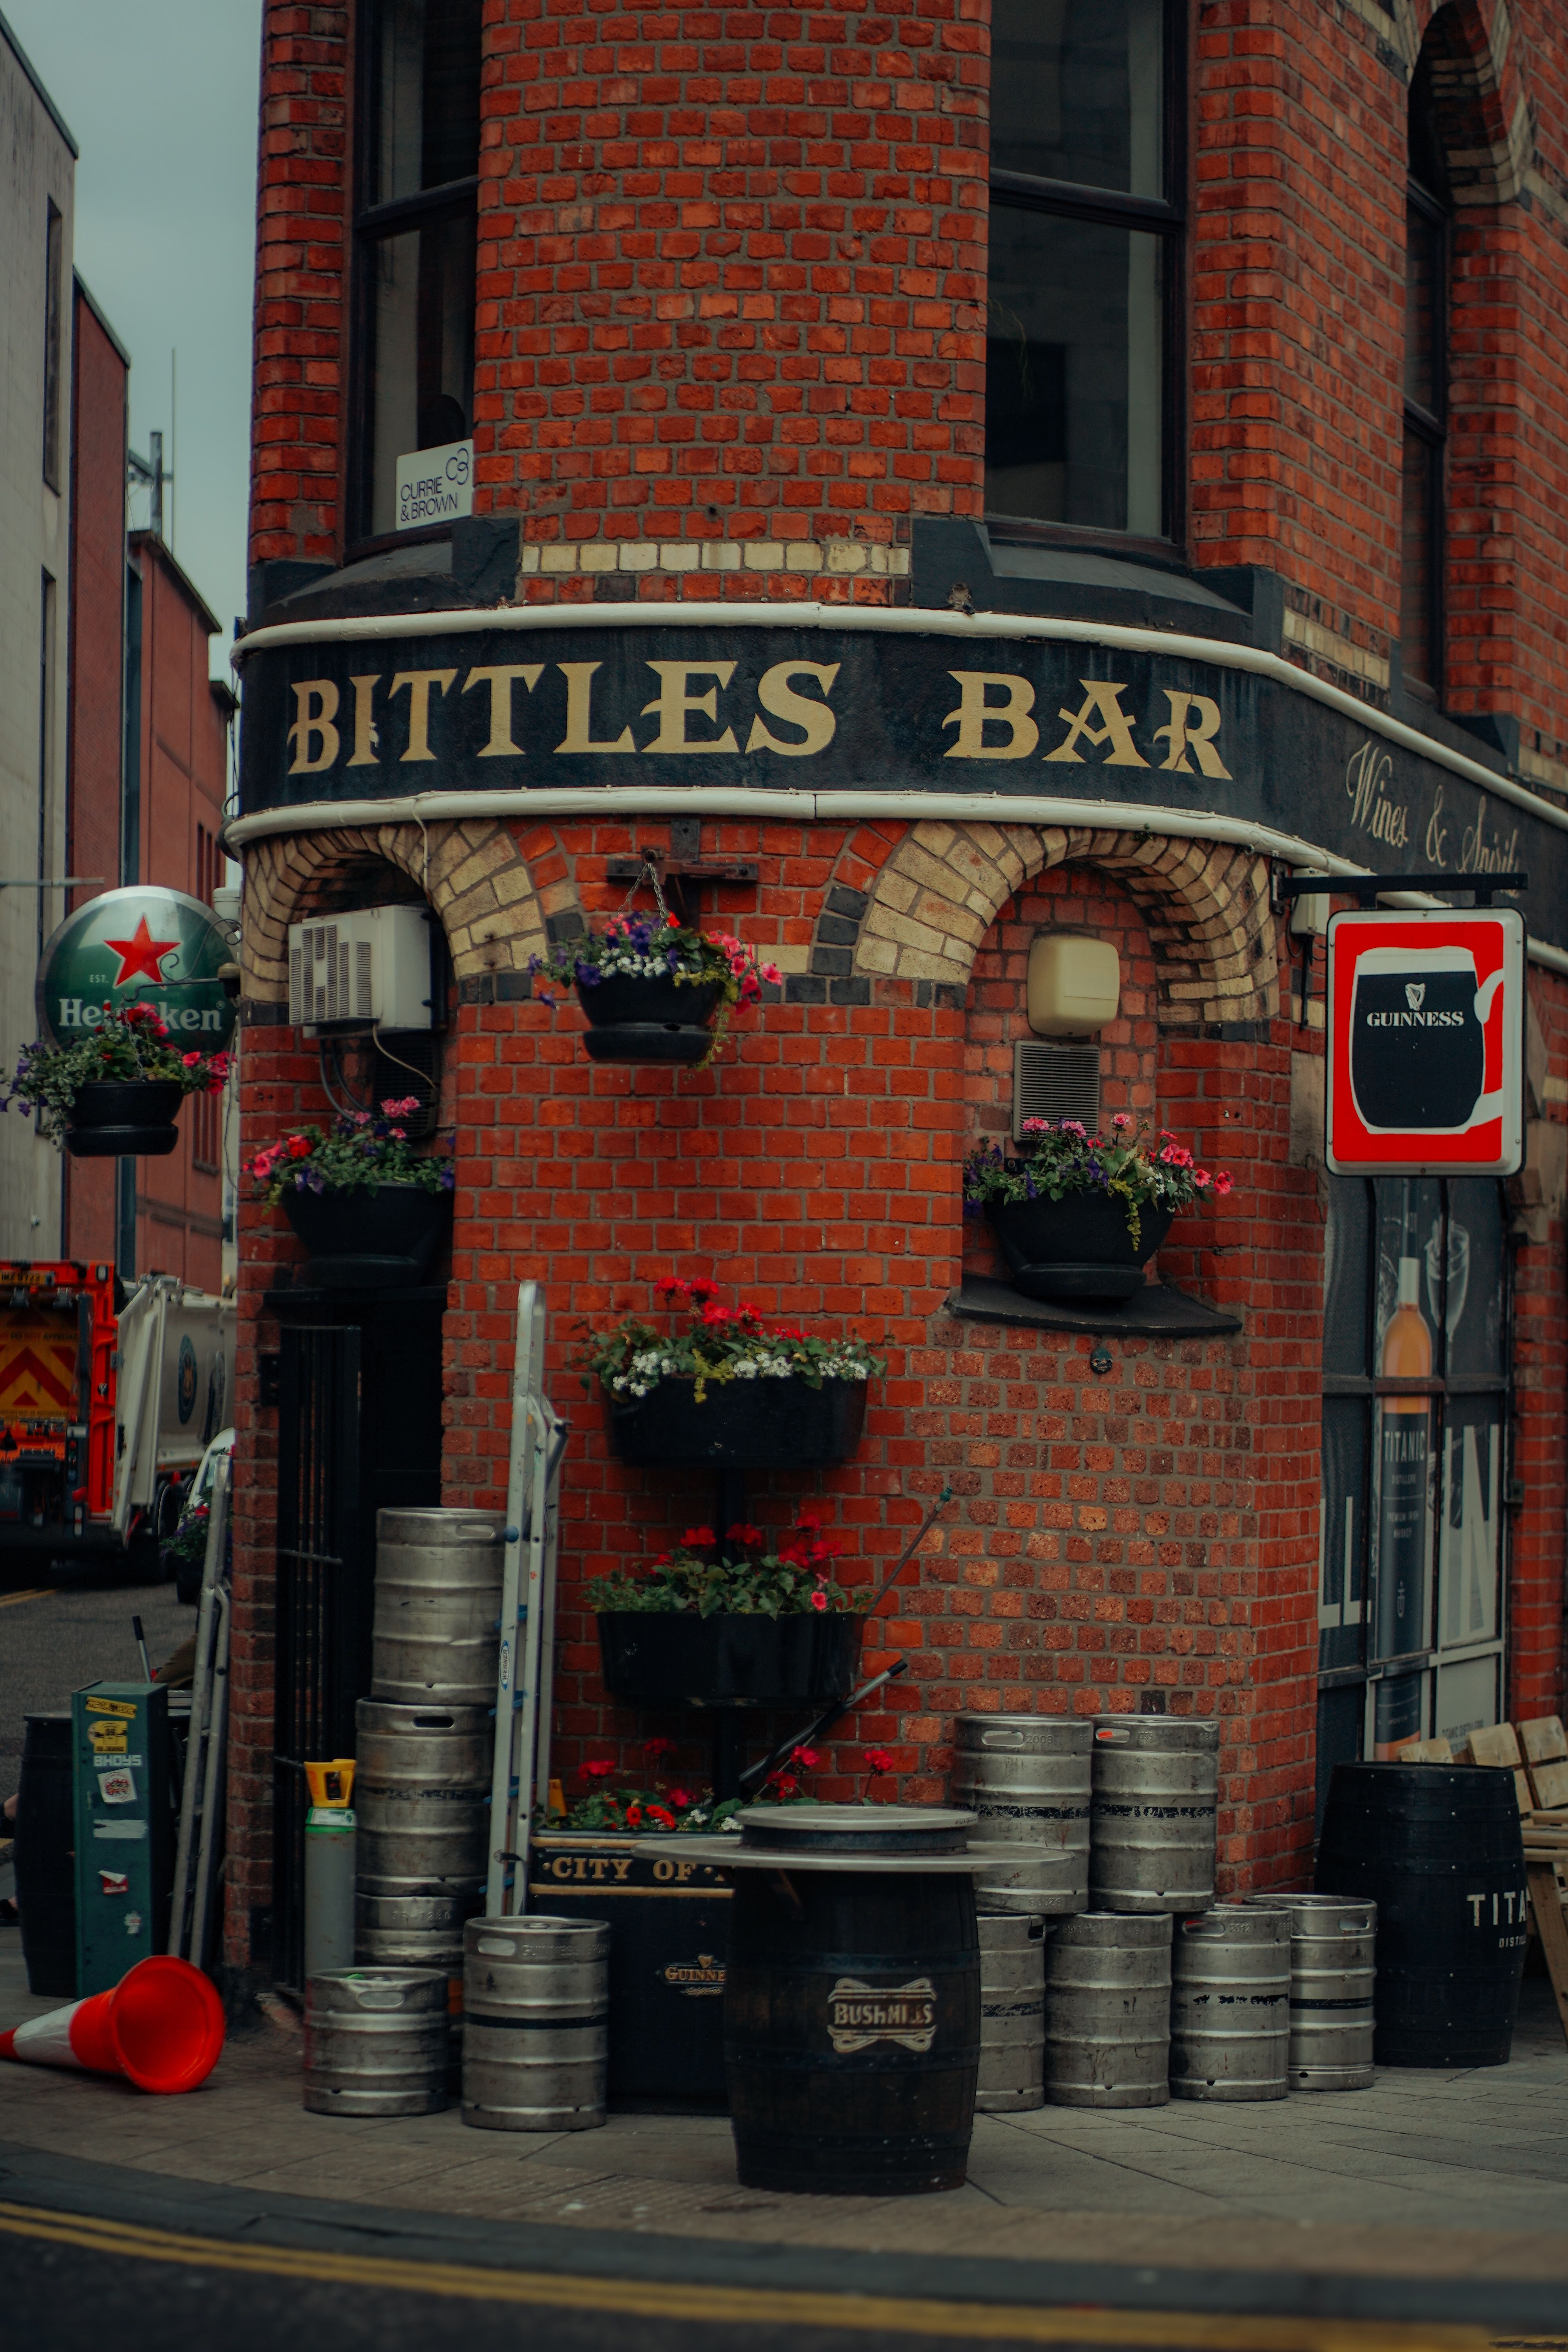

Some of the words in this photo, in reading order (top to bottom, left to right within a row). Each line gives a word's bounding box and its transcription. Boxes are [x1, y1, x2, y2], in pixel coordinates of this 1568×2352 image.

[401, 476, 443, 501] CURRIE
[400, 504, 410, 522] &
[411, 492, 457, 519] BROWN
[287, 660, 841, 774] BITTLES
[942, 670, 1233, 781] BAR
[1346, 740, 1408, 848] Wines
[1425, 785, 1447, 868] &
[89, 975, 109, 983] EST.
[1367, 1011, 1465, 1027] GUINNESS
[1384, 1430, 1425, 1462] TITANIC
[94, 1755, 142, 1766] BHOYS
[551, 1857, 633, 1880] CITY
[652, 1859, 697, 1881] OF
[1229, 1923, 1251, 1933] 2012
